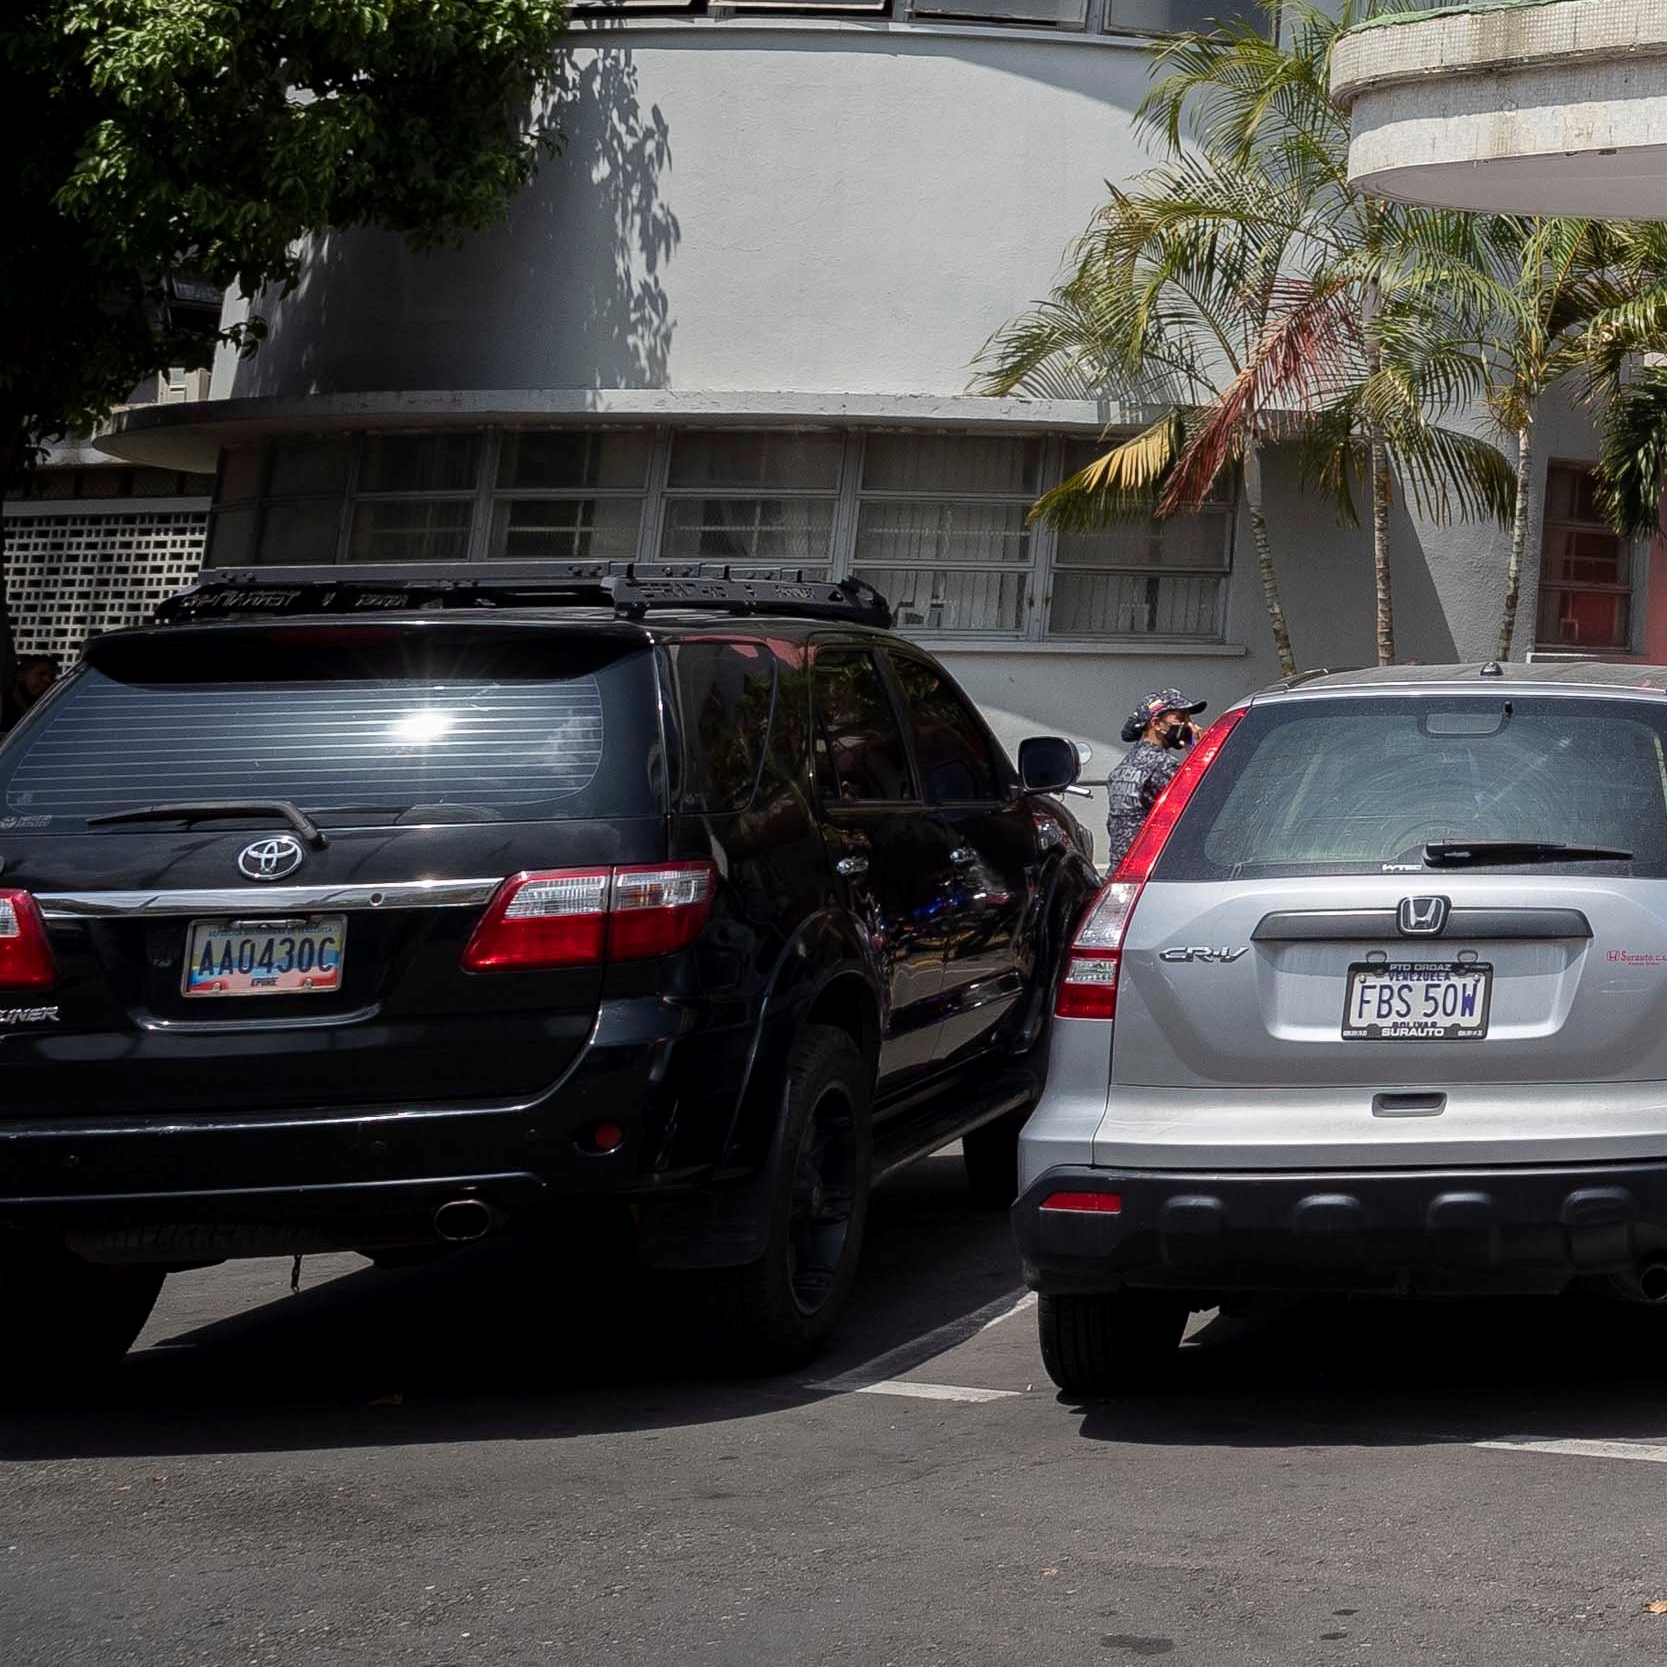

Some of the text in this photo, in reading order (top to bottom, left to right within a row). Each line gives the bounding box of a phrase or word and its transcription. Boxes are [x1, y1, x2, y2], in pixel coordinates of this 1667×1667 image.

[1160, 946, 1249, 963] CR-V
[1389, 963, 1452, 972] PTO ORDAZ
[1388, 972, 1451, 982] VENEZUELA
[1358, 983, 1477, 1019] FBS 50W
[1382, 1028, 1445, 1037] SURAUTO
